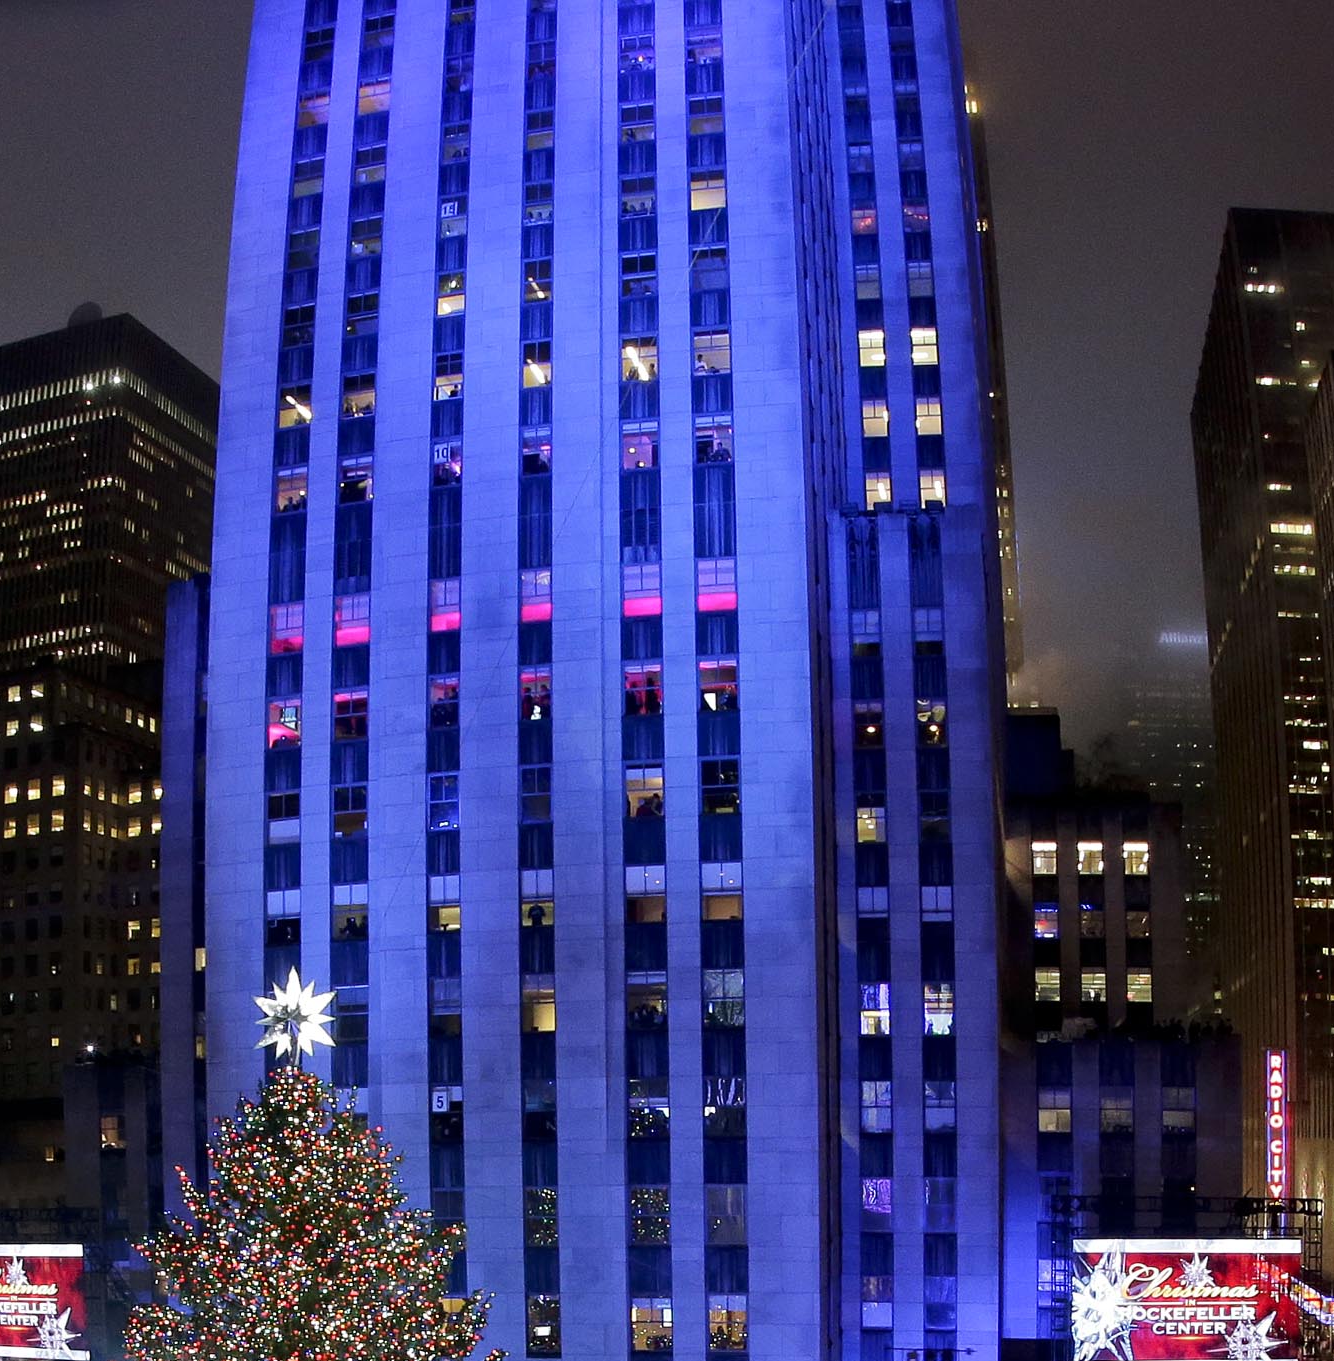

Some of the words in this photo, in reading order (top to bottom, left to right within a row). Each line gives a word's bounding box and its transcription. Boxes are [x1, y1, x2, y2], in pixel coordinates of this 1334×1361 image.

[1269, 1055, 1283, 1128] RADIO
[1269, 1141, 1283, 1198] CITY
[1121, 1263, 1258, 1299] Christmas
[1152, 1321, 1227, 1335] CENTER
